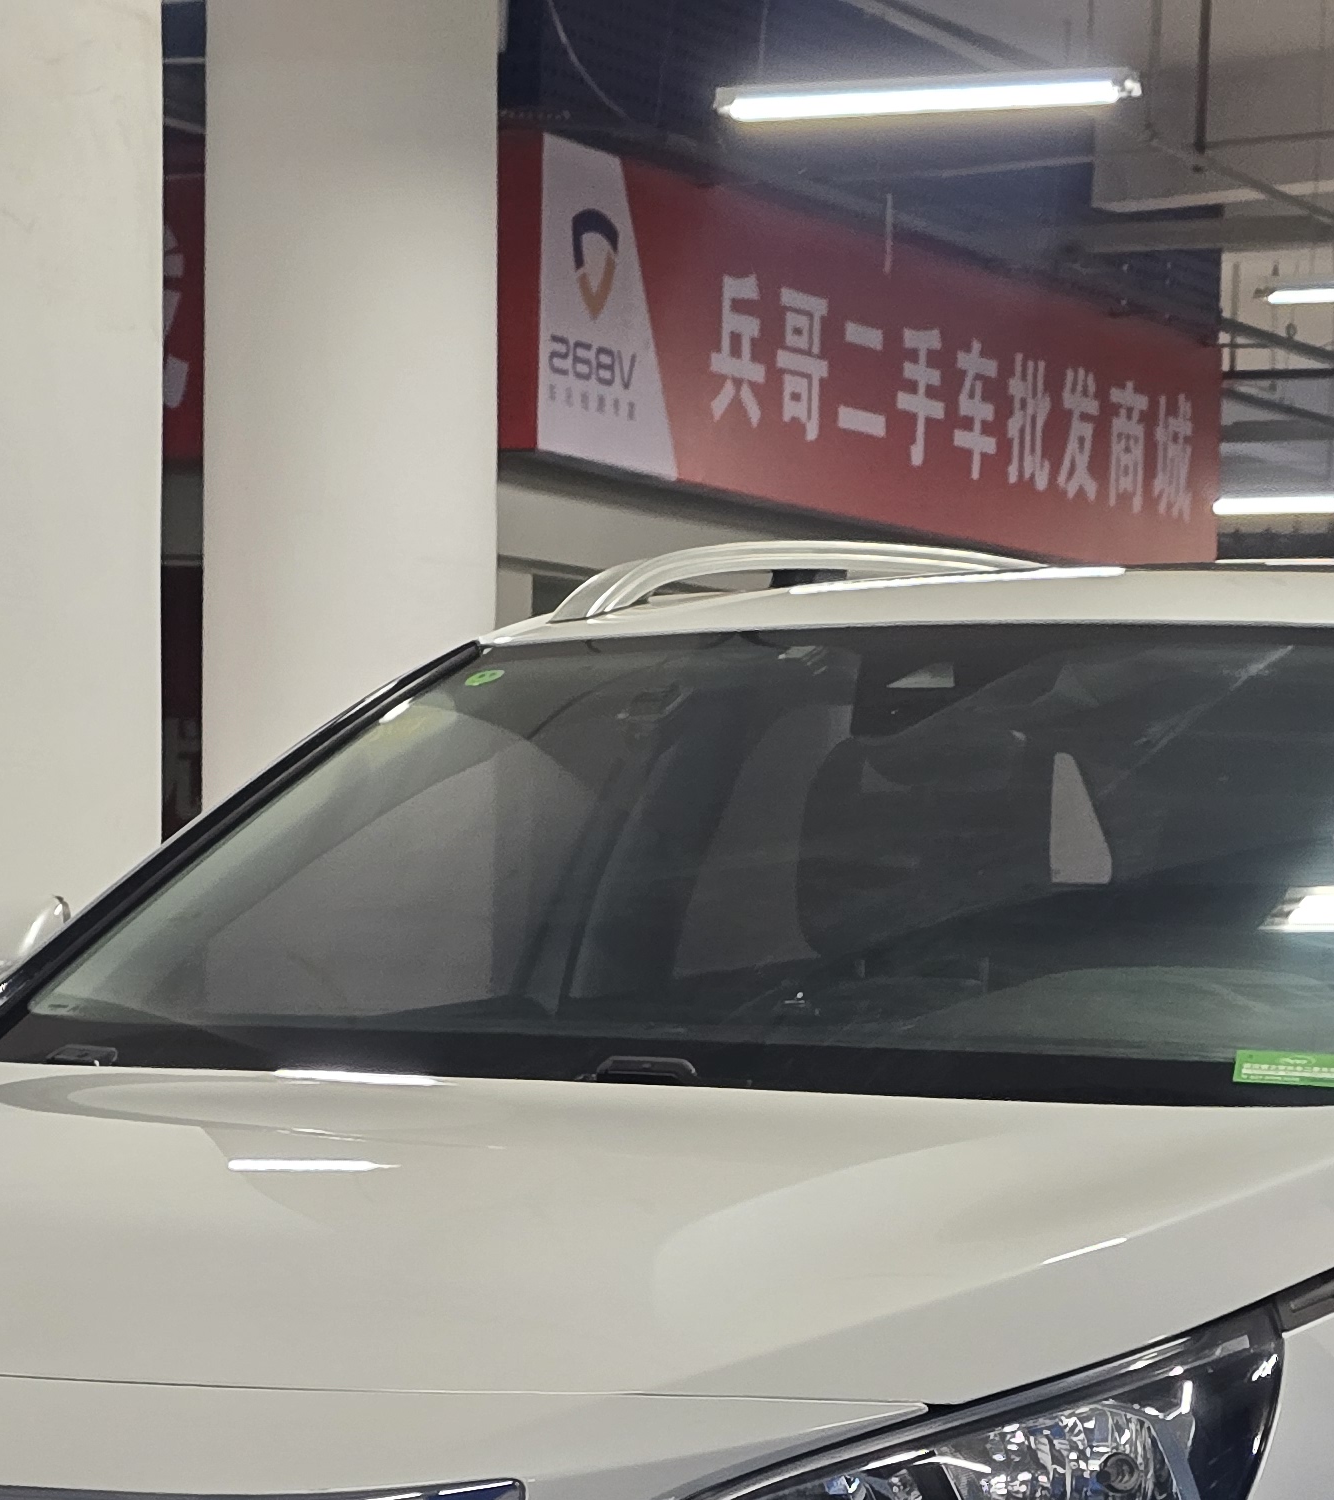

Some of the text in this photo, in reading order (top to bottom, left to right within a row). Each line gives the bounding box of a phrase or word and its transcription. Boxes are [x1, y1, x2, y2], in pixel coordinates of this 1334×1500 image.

[547, 333, 637, 391] 268V
[710, 273, 1194, 523] 兵哥二手车批发商城
